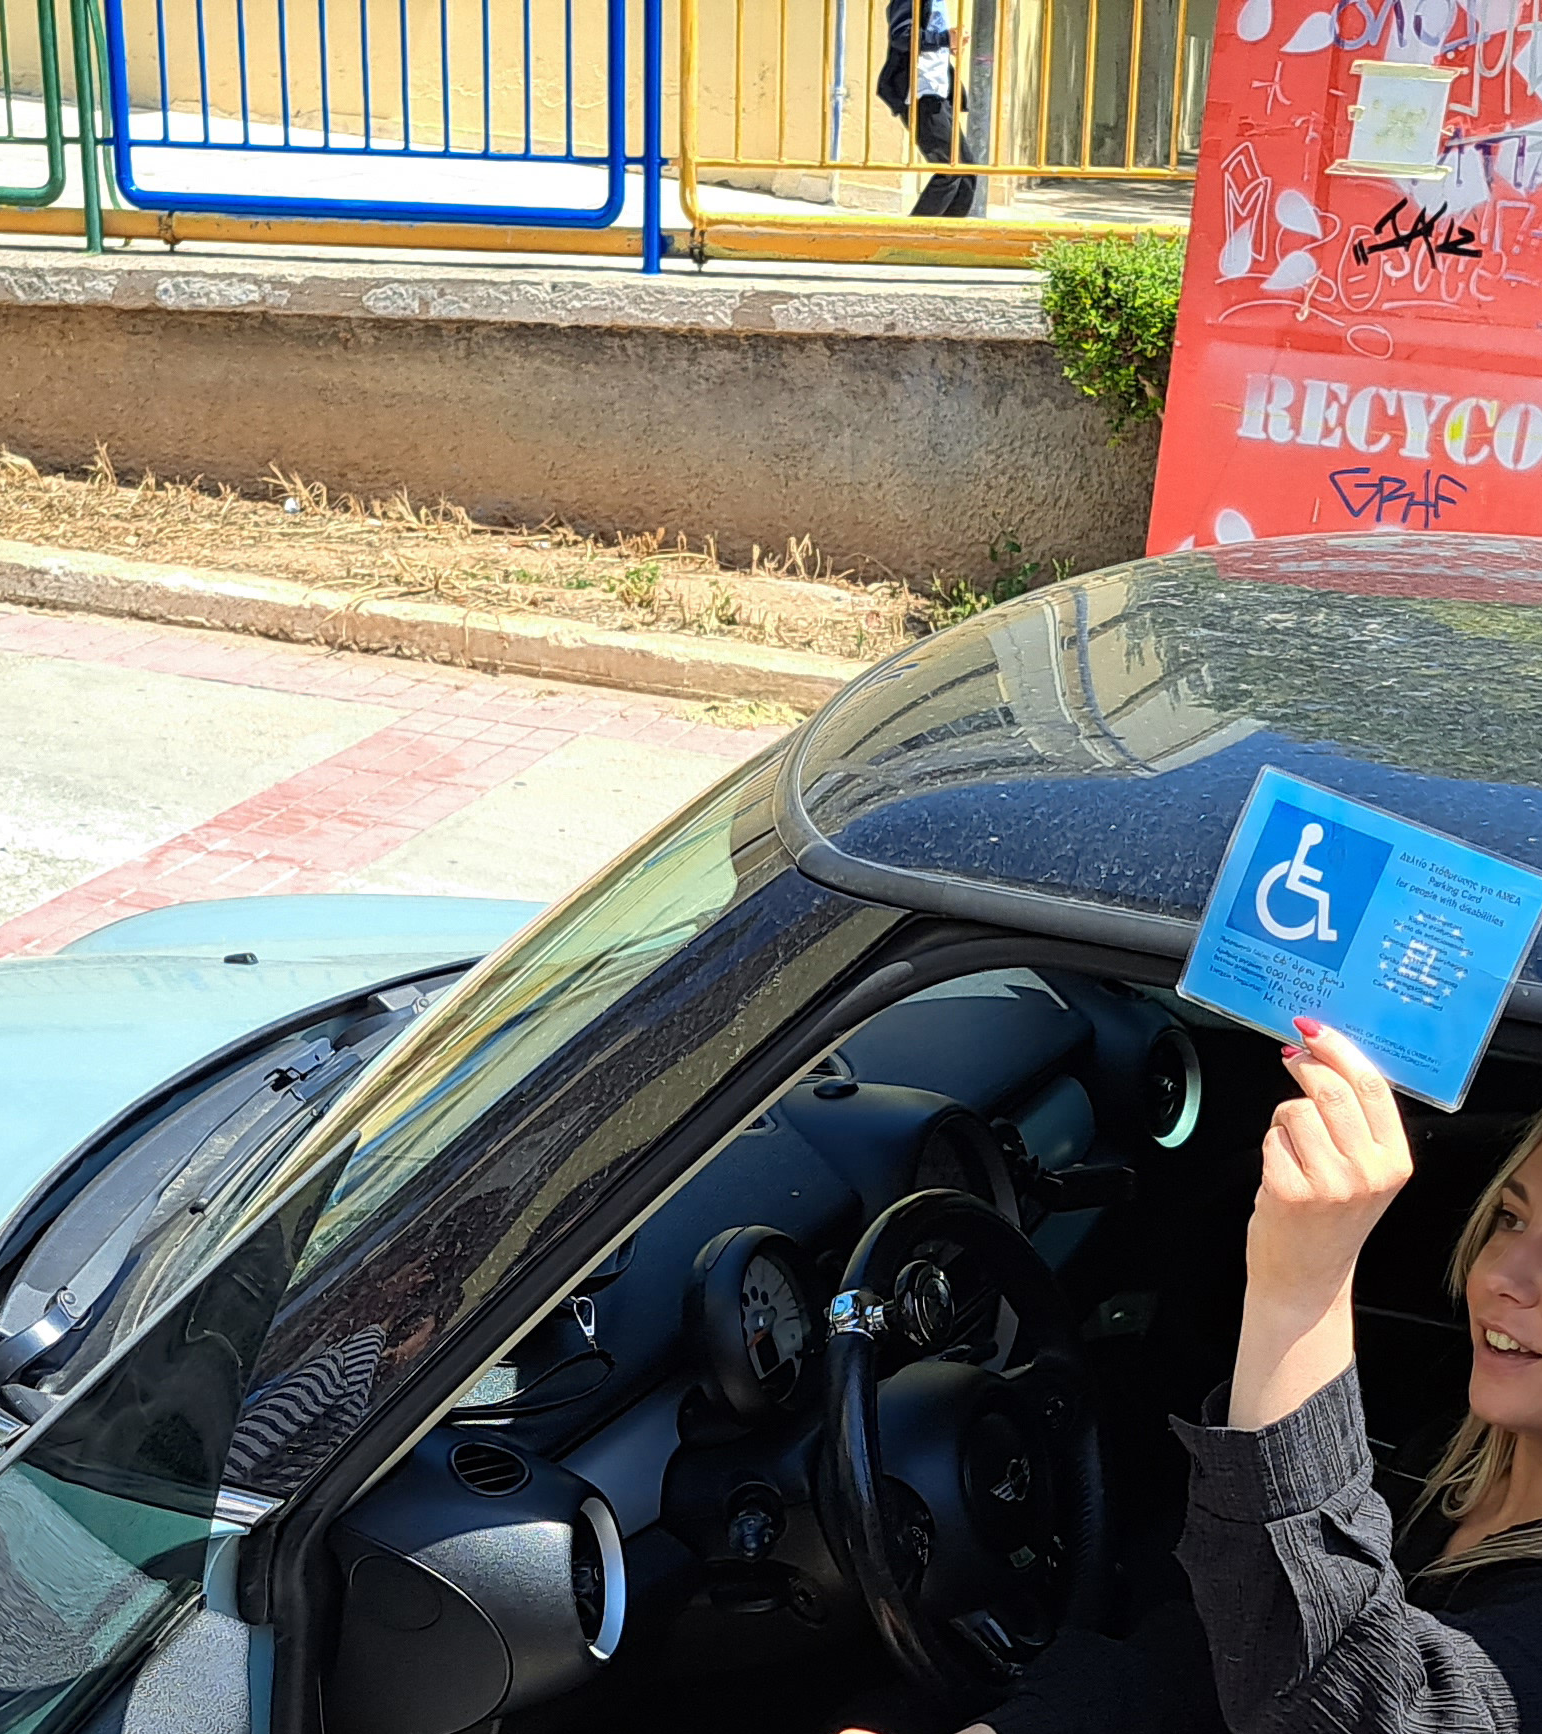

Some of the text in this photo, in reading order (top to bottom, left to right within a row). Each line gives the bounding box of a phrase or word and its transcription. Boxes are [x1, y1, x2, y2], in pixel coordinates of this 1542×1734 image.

[1427, 876, 1460, 897] Parking
[1409, 885, 1438, 902] people
[1439, 895, 1457, 909] with
[1459, 903, 1505, 928] disabilities
